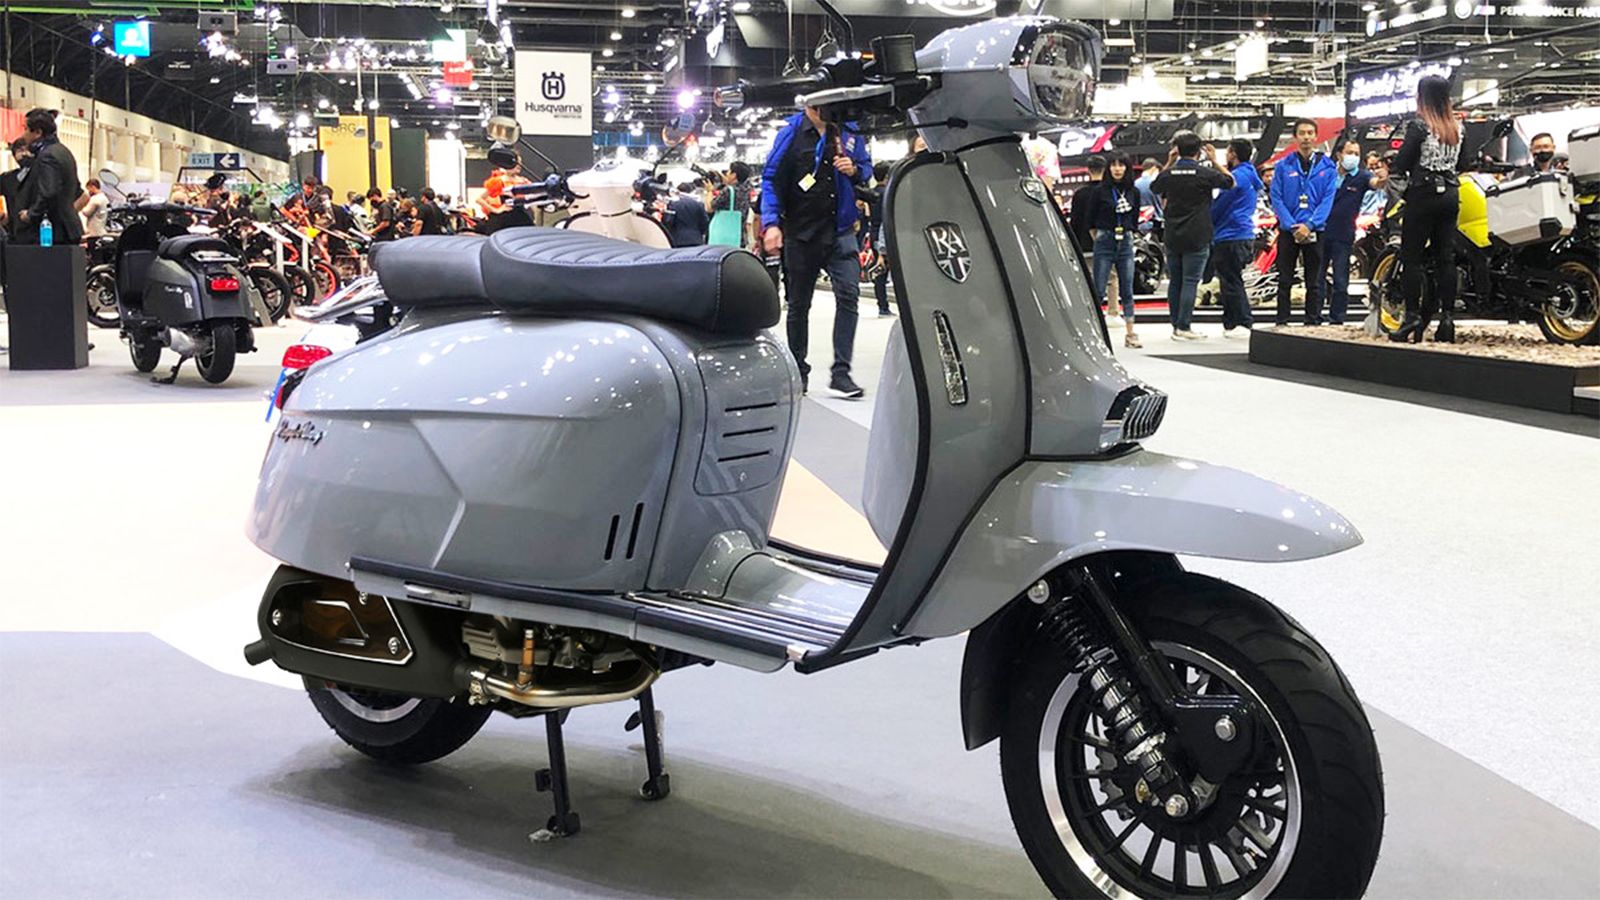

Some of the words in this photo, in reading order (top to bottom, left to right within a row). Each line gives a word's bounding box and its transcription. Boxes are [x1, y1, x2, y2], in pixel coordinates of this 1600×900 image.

[525, 102, 582, 114] Husqvarna
[191, 157, 210, 165] EXIT
[929, 226, 967, 258] RA
